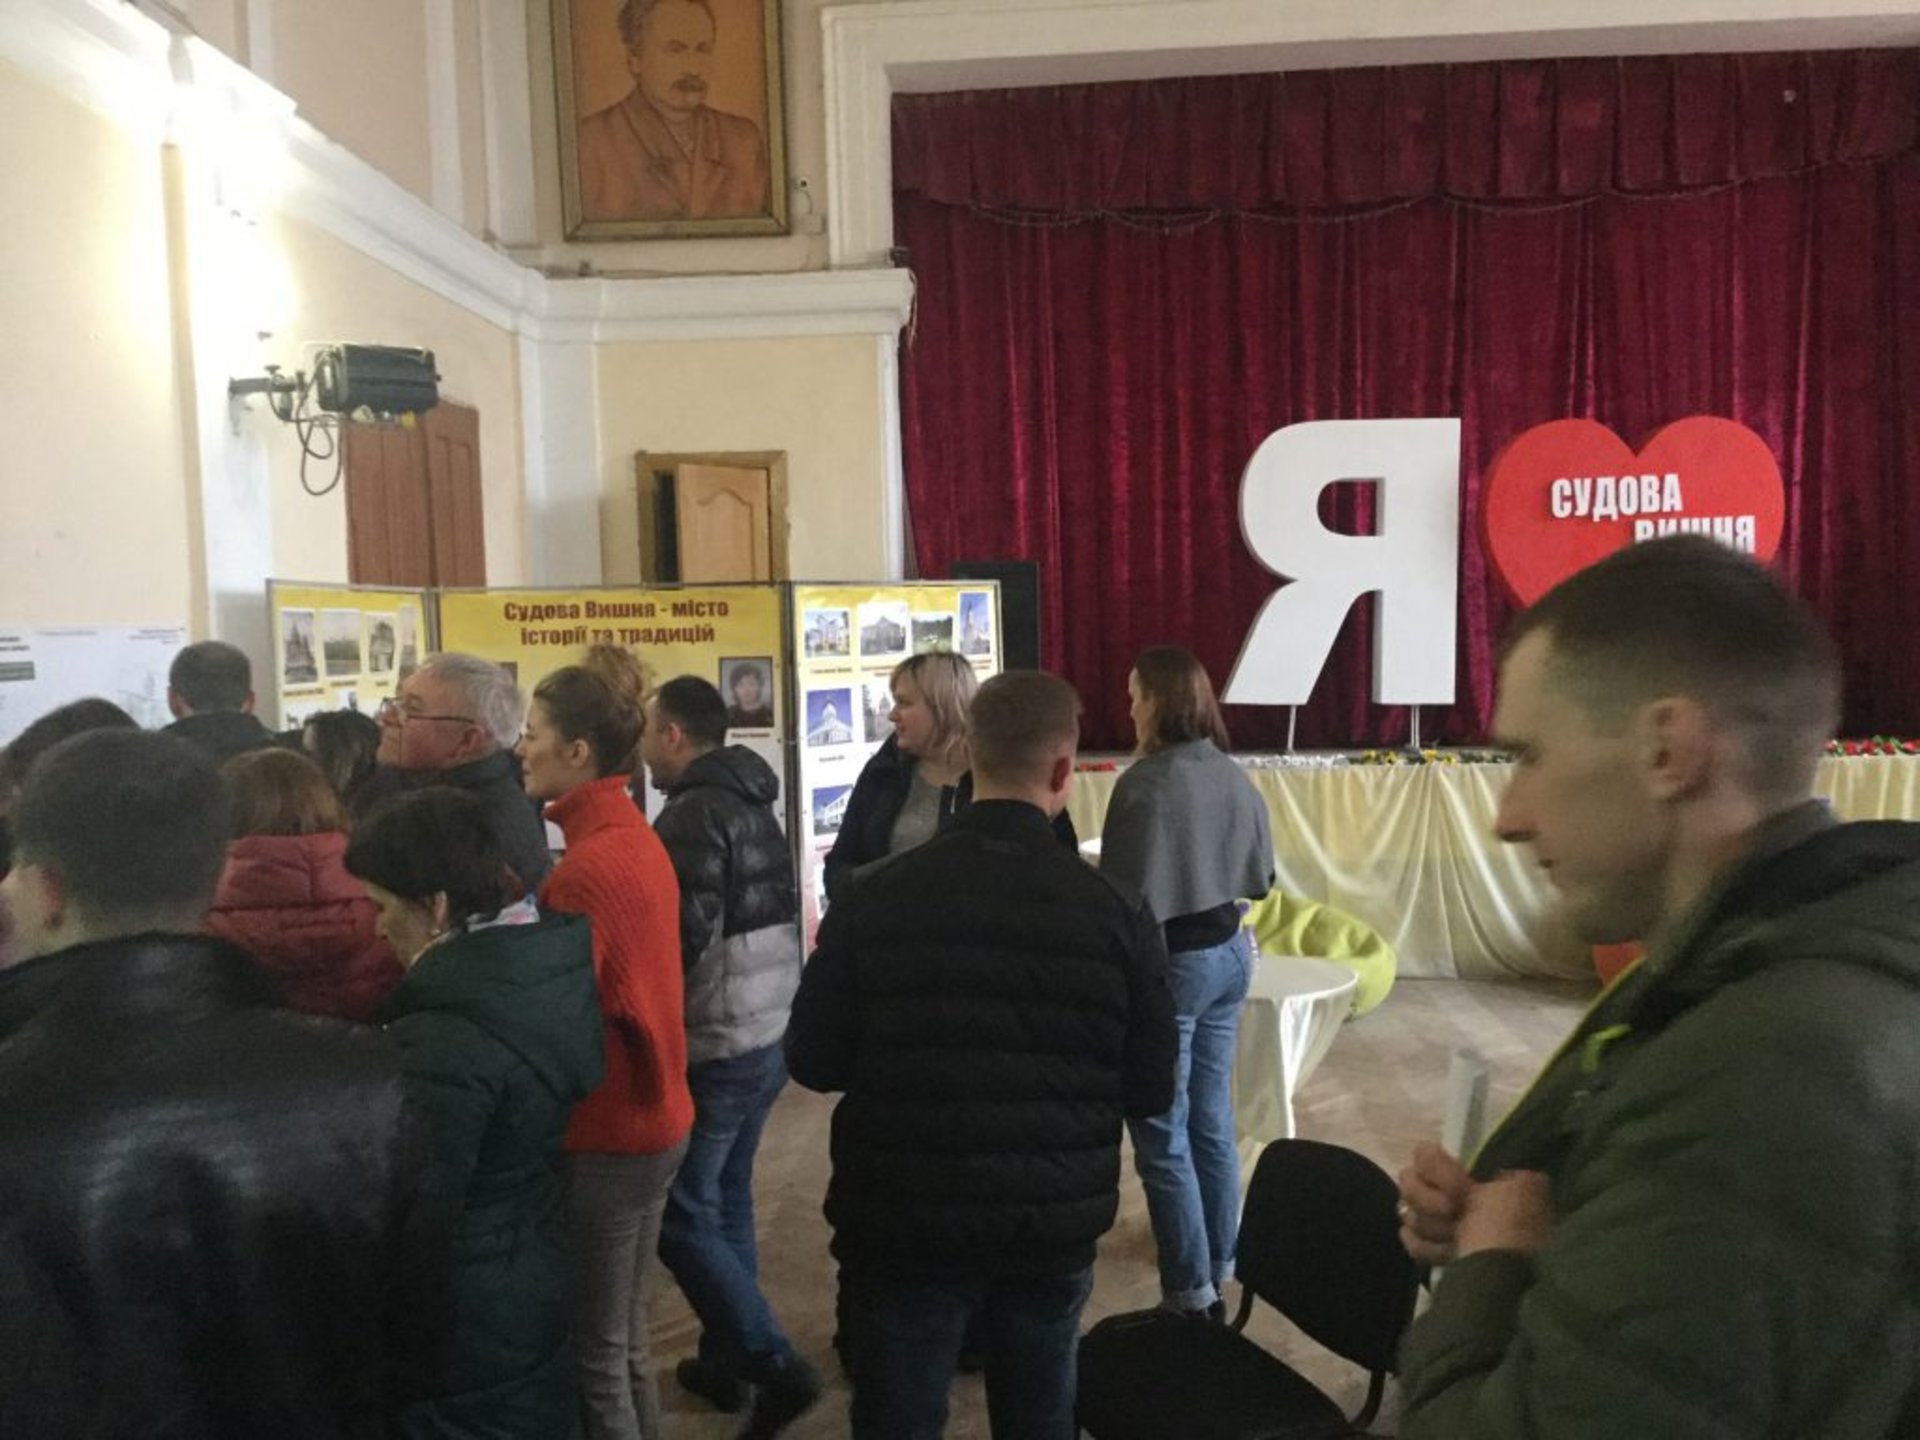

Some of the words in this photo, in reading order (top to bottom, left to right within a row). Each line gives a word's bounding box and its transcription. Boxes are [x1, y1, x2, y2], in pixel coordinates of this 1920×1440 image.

[1551, 473, 1683, 522] СУДОВА
[1220, 417, 1461, 704] Я
[504, 601, 580, 622] Судова
[585, 600, 655, 619] Вишня
[672, 599, 729, 618] місто
[521, 626, 587, 646] історії
[592, 629, 614, 643] та
[620, 624, 714, 645] традицій
